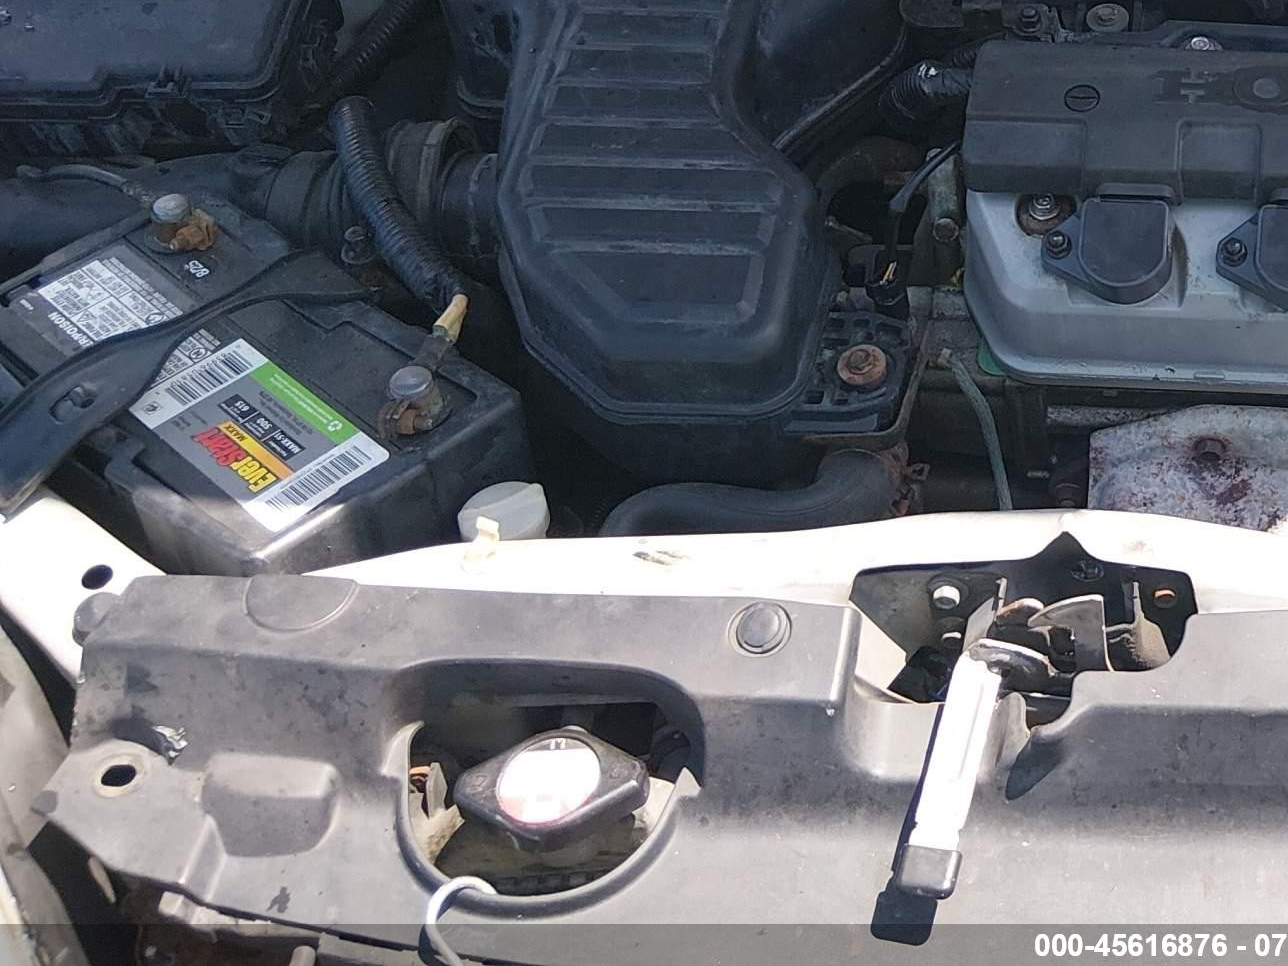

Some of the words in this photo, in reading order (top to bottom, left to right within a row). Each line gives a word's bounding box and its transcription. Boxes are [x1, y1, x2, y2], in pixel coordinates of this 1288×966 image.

[189, 261, 209, 277] 8/25
[234, 400, 250, 412] 615
[256, 417, 273, 430] 500
[223, 424, 248, 442] MAXX
[190, 425, 278, 495] EverStart
